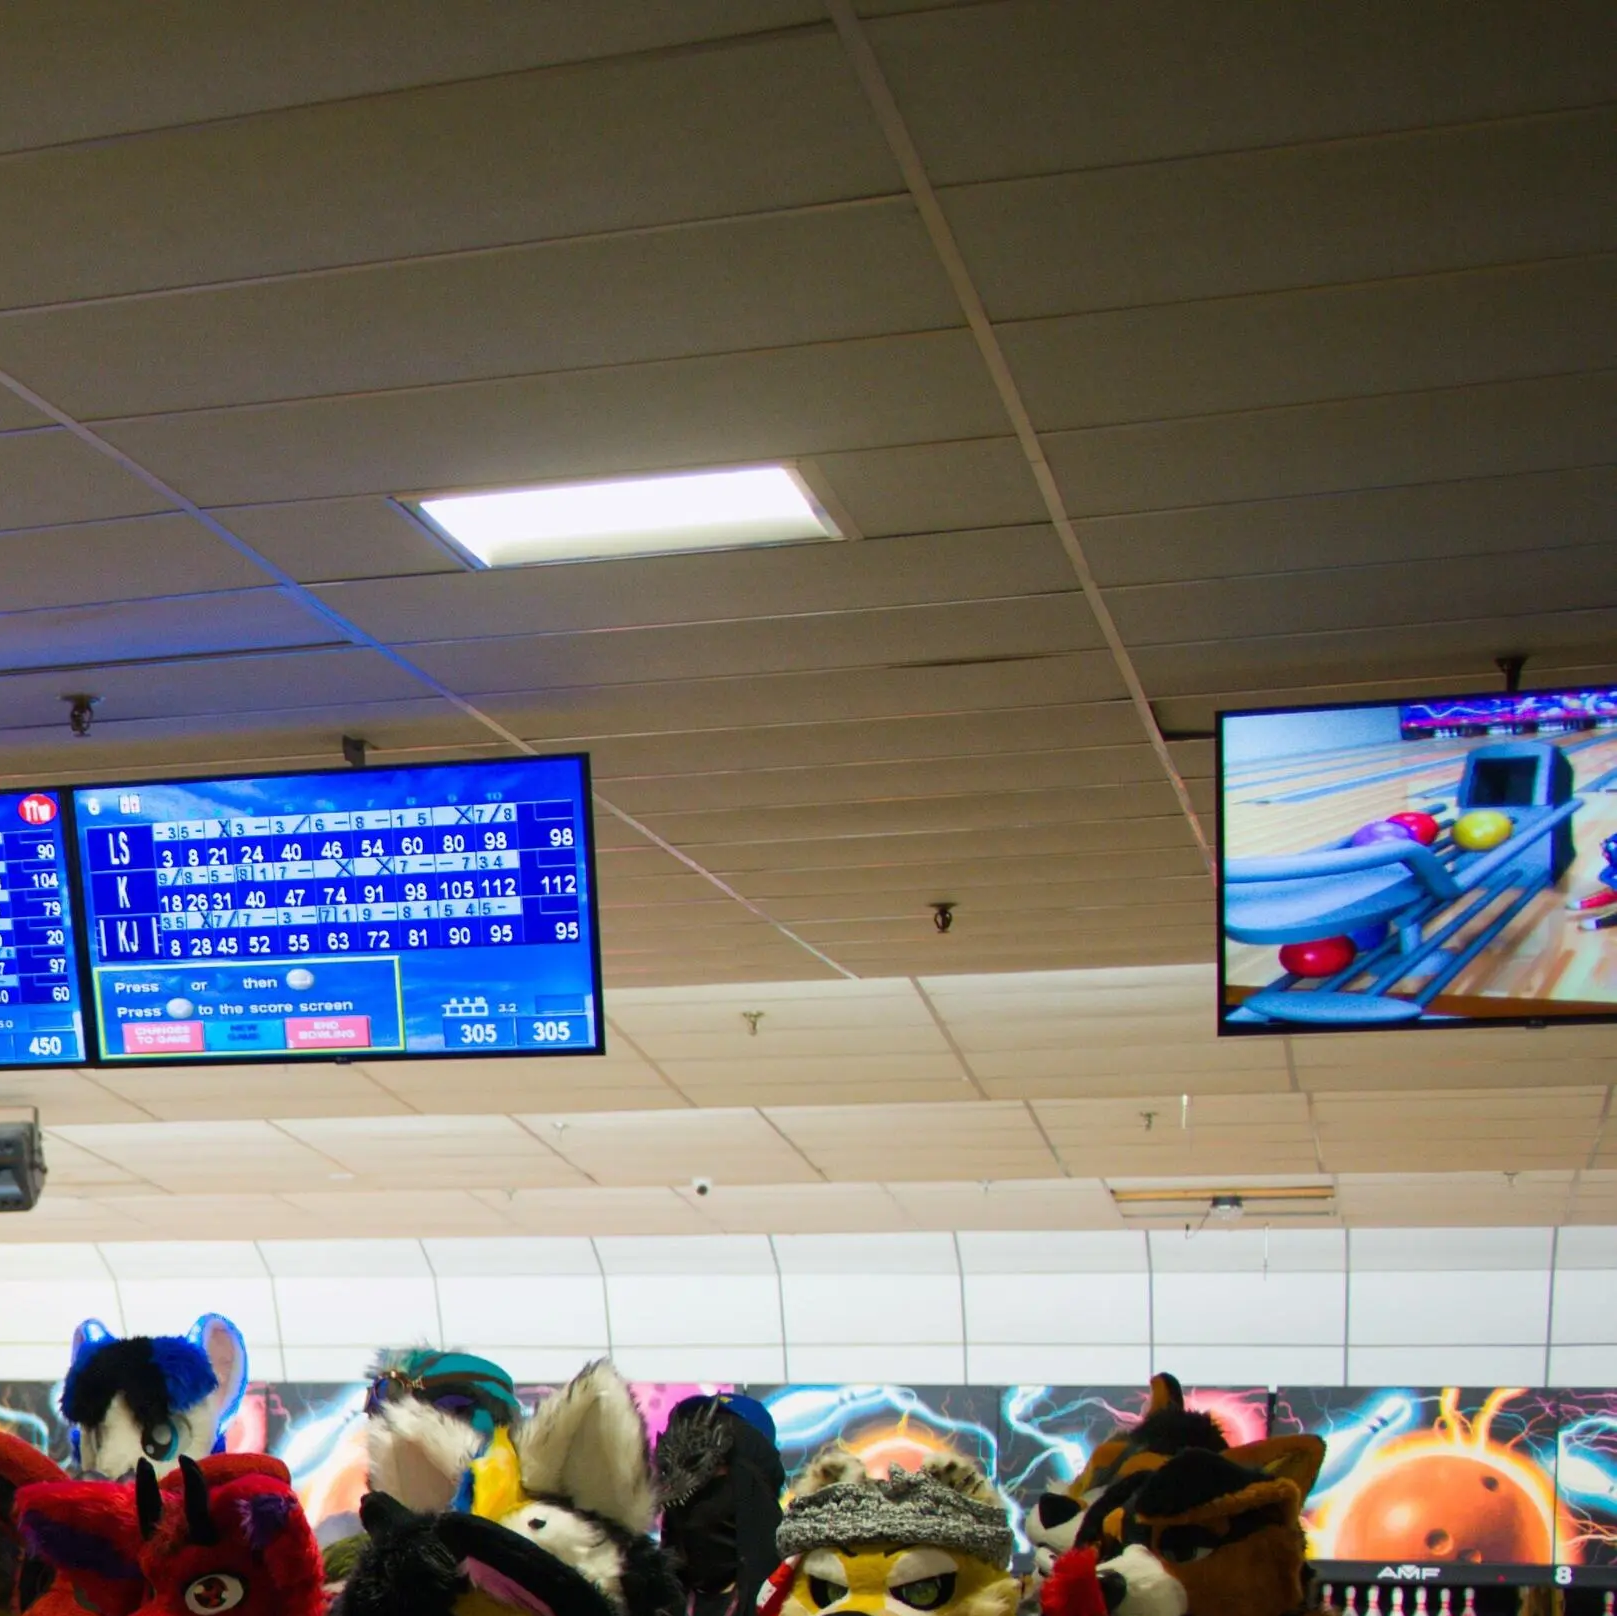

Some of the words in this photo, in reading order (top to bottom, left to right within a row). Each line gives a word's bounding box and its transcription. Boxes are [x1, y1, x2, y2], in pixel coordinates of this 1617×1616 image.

[37, 844, 55, 859] 90
[109, 832, 130, 865] LS
[163, 851, 173, 867] 3
[189, 850, 199, 866] 8
[209, 848, 227, 864] 21
[241, 846, 263, 863] 24
[281, 844, 301, 860] 40
[321, 841, 342, 858] 46
[362, 839, 383, 856] 54
[401, 837, 423, 854] 60
[443, 835, 464, 851] 80
[485, 832, 507, 849] 98
[550, 828, 573, 846] 98
[32, 873, 58, 888] 104
[118, 876, 130, 908] K
[161, 896, 182, 911] 18
[187, 894, 208, 910] 26
[213, 893, 231, 909] 31
[246, 891, 265, 907] 40
[285, 890, 305, 906] 47
[324, 888, 347, 904] 74
[364, 885, 383, 902] 91
[405, 883, 427, 900] 98
[440, 881, 474, 898] 105
[482, 878, 515, 896] 112
[542, 875, 576, 894] 112
[43, 901, 61, 916] 79
[46, 930, 64, 944] 20
[118, 921, 138, 952] KJ
[171, 940, 181, 956] 8
[190, 939, 211, 955] 28
[218, 937, 238, 953] 45
[249, 936, 270, 952] 52
[288, 935, 309, 951] 55
[328, 932, 349, 949] 63
[368, 931, 390, 948] 72
[409, 929, 428, 946] 81
[449, 927, 470, 944] 90
[490, 925, 513, 942] 95
[555, 922, 578, 940] 95
[50, 958, 66, 973] 97
[53, 987, 69, 1001] 60
[115, 982, 159, 994] Press
[191, 981, 207, 991] or
[243, 978, 277, 989] then
[118, 1007, 161, 1018] Press
[199, 1005, 212, 1016] to
[220, 1003, 243, 1014] the
[250, 1002, 292, 1013] score
[300, 1001, 353, 1012] screen
[461, 1024, 497, 1043] 305
[533, 1022, 570, 1041] 305
[30, 1036, 61, 1055] 450
[1377, 1565, 1440, 1580] AMF
[1554, 1567, 1572, 1584] 8
